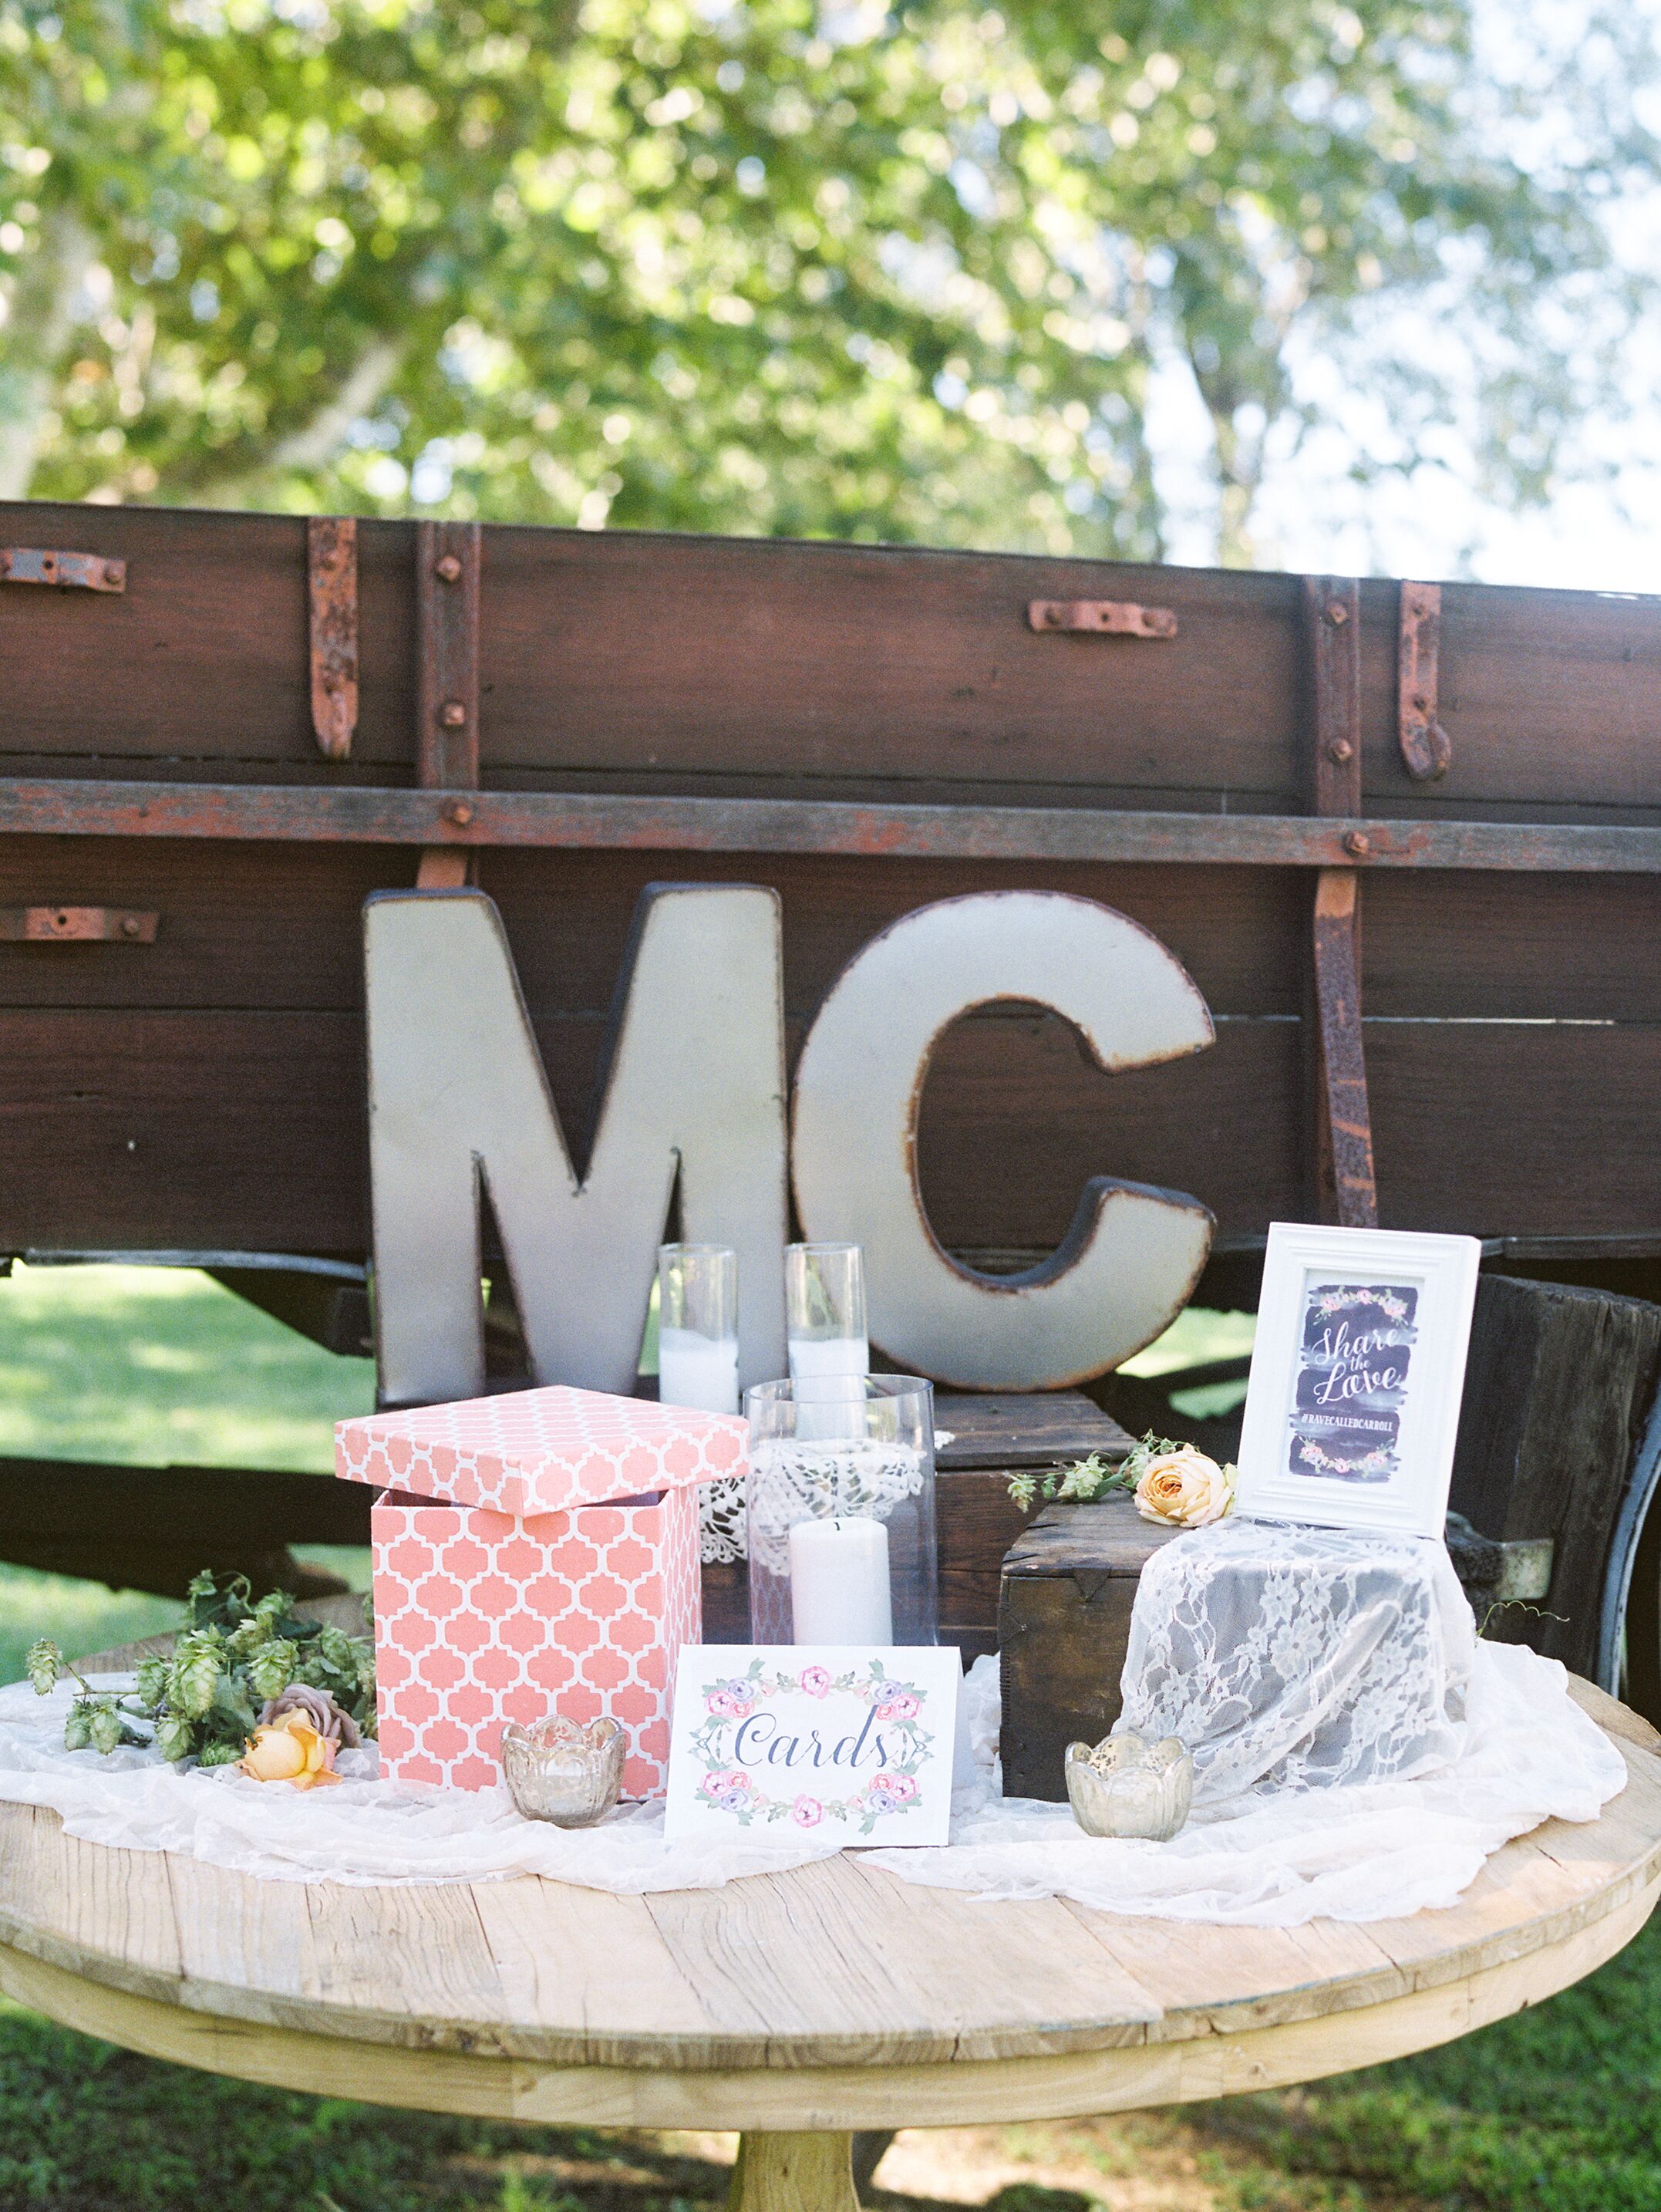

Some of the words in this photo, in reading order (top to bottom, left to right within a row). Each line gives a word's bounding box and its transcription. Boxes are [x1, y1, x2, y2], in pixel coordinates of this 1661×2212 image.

[1312, 1321, 1400, 1364] Share
[1350, 1353, 1370, 1372] the
[1313, 1361, 1402, 1405] Love
[734, 1704, 899, 1768] Cards
